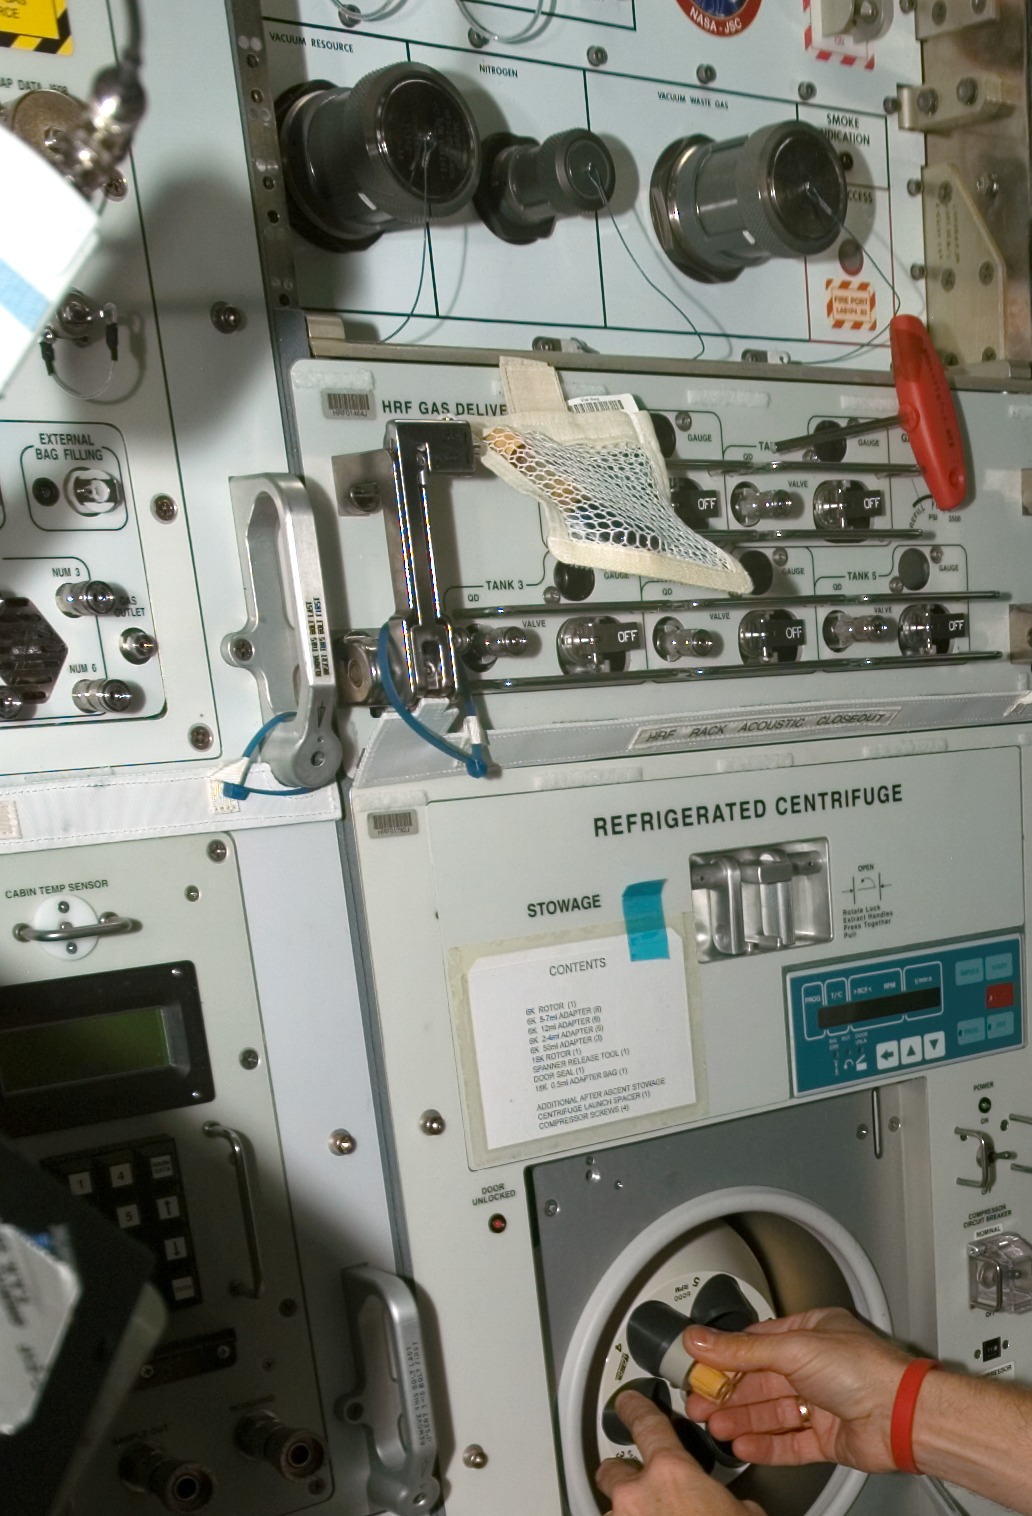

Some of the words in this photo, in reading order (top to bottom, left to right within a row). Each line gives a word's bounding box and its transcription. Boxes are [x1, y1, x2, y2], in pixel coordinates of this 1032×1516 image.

[688, 7, 717, 34] NASA
[724, 17, 742, 34] JSC
[268, 31, 307, 46] VACUUM
[310, 38, 354, 53] RESOURCE
[479, 63, 518, 78] NITROGEN
[657, 91, 686, 102] VACUUM
[690, 95, 711, 107] WASTE
[715, 99, 729, 109] GAS
[826, 113, 860, 129] SMOKE
[381, 399, 412, 415] HRF
[418, 400, 451, 415] GAS
[454, 401, 508, 417] DELIVE
[39, 432, 95, 447] EXTERNAL
[687, 434, 712, 443] GAUGE
[857, 438, 880, 448] GAUGE
[35, 448, 59, 461] BAG
[63, 448, 104, 462] FILLING
[788, 479, 809, 488] VALVE
[697, 498, 717, 510] OFF
[863, 497, 881, 509] OFF
[52, 568, 71, 577] NUM
[75, 568, 81, 577] 3
[781, 566, 805, 576] GAUGE
[938, 564, 960, 573] GAUGE
[847, 571, 869, 581] TANK
[871, 571, 877, 581] 5
[486, 580, 517, 590] TANK
[518, 580, 524, 590] 3
[662, 587, 673, 596] QD
[120, 596, 137, 606] GAS
[467, 594, 480, 602] QD
[115, 607, 146, 617] OUTLET
[873, 606, 893, 614] VALVE
[709, 612, 731, 621] VALVE
[521, 619, 547, 628] VALVE
[948, 619, 964, 631] OFF
[617, 630, 639, 643] OFF
[785, 627, 803, 640] OFF
[69, 664, 88, 674] NUM
[91, 663, 97, 673] 6
[647, 729, 676, 743] HRF
[688, 724, 728, 738] RACK
[737, 718, 806, 733] ACOUSTIC
[816, 713, 886, 726] CLOSEOUT
[592, 800, 767, 837] REFRIGERATED
[775, 784, 903, 816] CENTRIFUGE
[857, 864, 875, 873] OPEN
[5, 886, 37, 899] CABIN
[38, 884, 66, 896] TEMP
[67, 879, 109, 893] SENSOR
[527, 894, 602, 918] STOWAGE
[867, 911, 894, 920] Handles
[843, 923, 862, 931] Press
[864, 918, 892, 928] Together
[549, 957, 607, 976] CONTENTS
[884, 981, 896, 990] RPM
[532, 1060, 567, 1074] SPANNER
[567, 1054, 600, 1067] RELEASE
[601, 1050, 620, 1060] TOOL
[620, 1047, 630, 1056] (1)
[973, 1081, 994, 1091] POWER
[537, 1097, 578, 1112] ADDITIONAL
[579, 1091, 603, 1103] AFTER
[603, 1086, 631, 1098] ASCENT
[632, 1077, 666, 1091] STOWAGE
[538, 1105, 582, 1120] CENTRIFUGE
[583, 1099, 612, 1112] LAUNCH
[613, 1093, 641, 1105] SPACER
[641, 1090, 651, 1099] (1)
[117, 1171, 126, 1183] 4
[481, 1182, 505, 1195] DOOR
[472, 1189, 516, 1206] UNLOCKED
[125, 1210, 134, 1223] 5
[968, 1203, 1007, 1220] COMPRESSOR
[963, 1216, 985, 1229] CIRCUIT
[986, 1209, 1012, 1222] BREAKER
[976, 1225, 1002, 1239] NOMINAL
[674, 1283, 689, 1293] RPM
